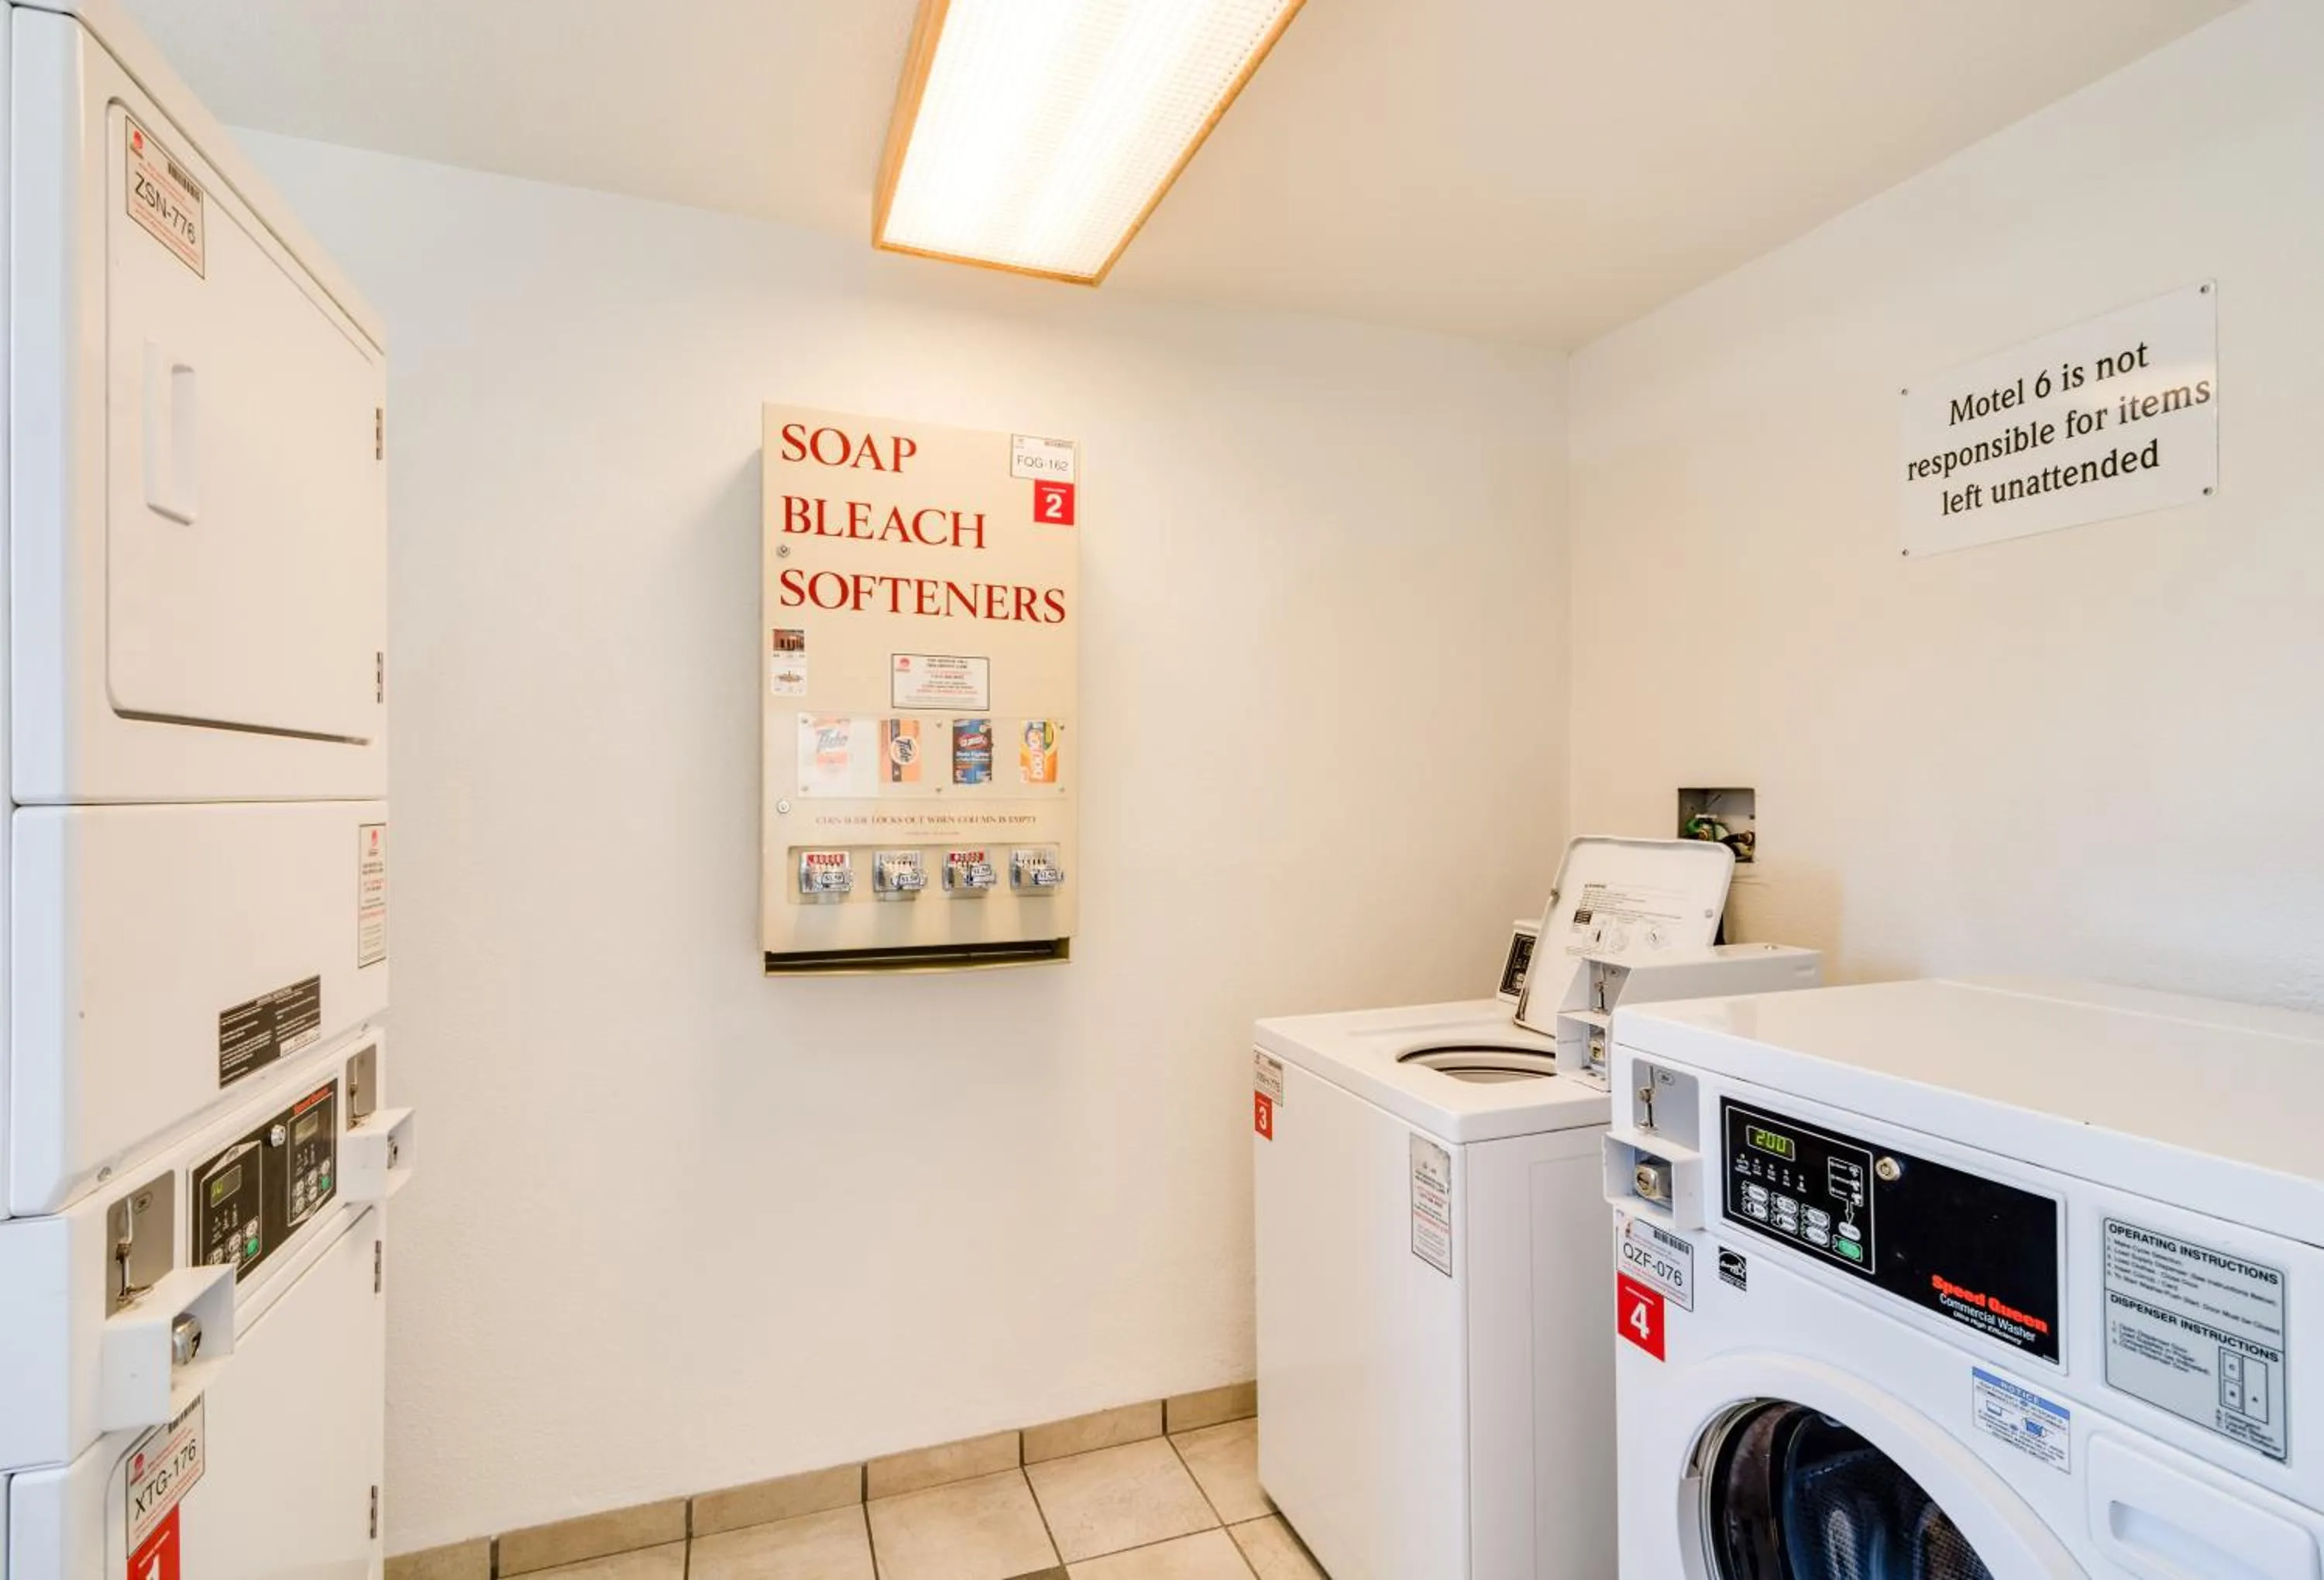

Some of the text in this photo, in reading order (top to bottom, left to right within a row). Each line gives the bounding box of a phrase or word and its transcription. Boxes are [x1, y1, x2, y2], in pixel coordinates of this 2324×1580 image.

[134, 171, 196, 246] ZSN-776
[1948, 342, 2149, 426] Motel 6 is not
[781, 424, 917, 473] SOAP
[1906, 380, 2211, 481] responsible for items
[1941, 438, 2161, 516] left unattended
[780, 495, 988, 549] BLEACH
[1045, 493, 1063, 519] 2
[780, 568, 1066, 624] SOFTENERS
[1259, 1105, 1267, 1130] 3
[1756, 1130, 1787, 1153] 200
[1623, 1242, 1683, 1287] QZF-076
[2109, 1223, 2279, 1285] OPERATING INSTRUCTIONS
[1630, 1302, 1650, 1341] 4
[1931, 1274, 2048, 1334] Speed Queen
[1939, 1293, 2036, 1342] Commercial Washer
[2110, 1293, 2279, 1363] DISPENSER INSTRUCTIONS
[135, 1438, 197, 1521] XTG-176
